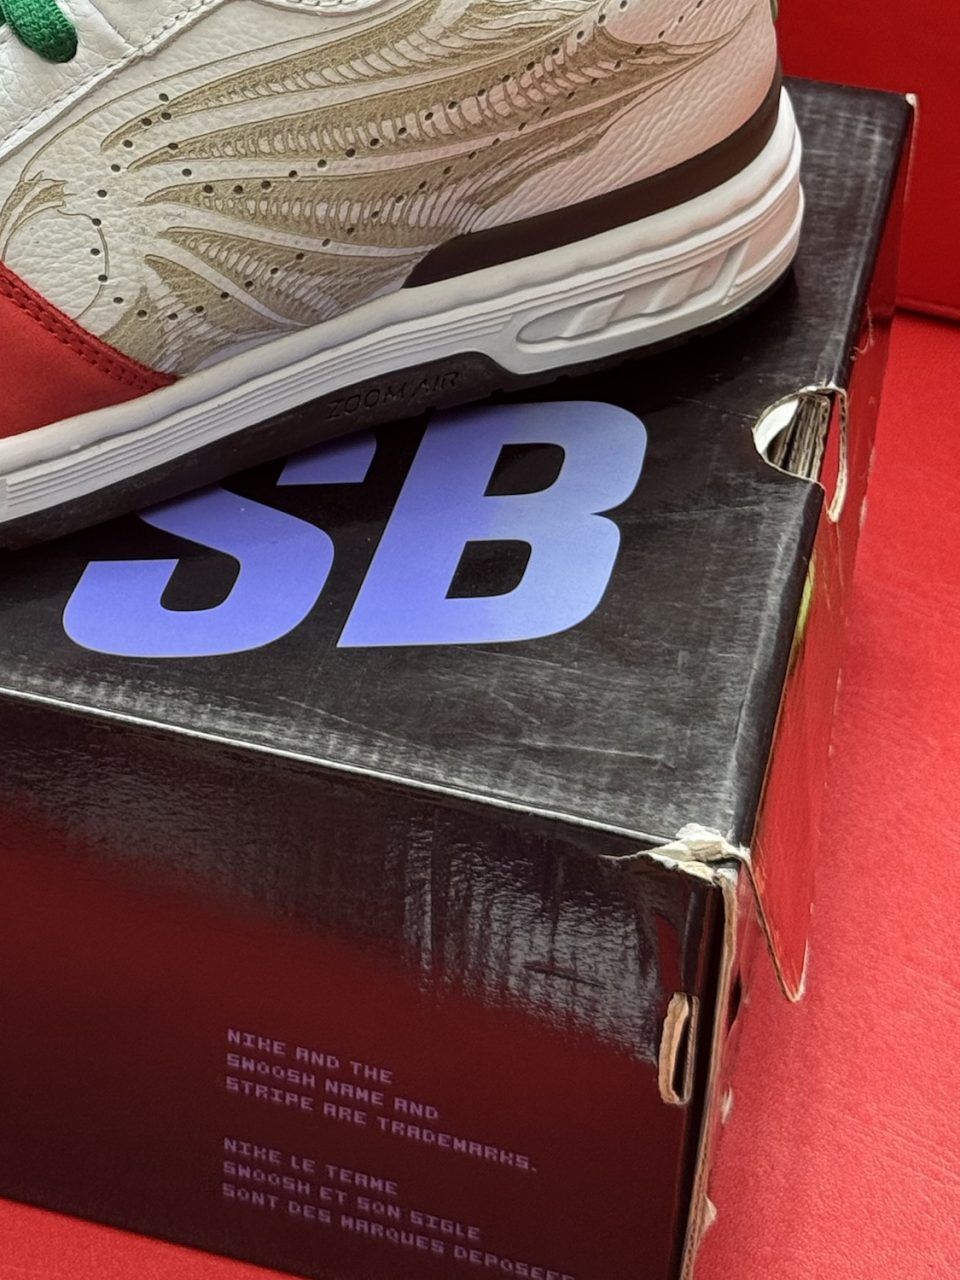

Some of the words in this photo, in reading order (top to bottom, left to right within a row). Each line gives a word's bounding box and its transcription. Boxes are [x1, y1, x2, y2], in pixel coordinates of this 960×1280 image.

[329, 382, 406, 418] ZOOM
[412, 371, 459, 397] AIR
[63, 400, 647, 658] SB
[227, 1028, 286, 1055] NIKE
[296, 1047, 339, 1069] AND
[350, 1061, 392, 1084] THE
[227, 1053, 315, 1088] SWOOSH
[325, 1078, 384, 1106] NAME
[394, 1097, 438, 1119] AND
[226, 1076, 313, 1111] STRIPE
[323, 1102, 367, 1125] ARE
[377, 1116, 537, 1173] TRADEMARKS.
[224, 1137, 281, 1164] NIKE
[291, 1155, 315, 1173] LE
[325, 1164, 398, 1195] TERME
[222, 1183, 279, 1209] SONT
[289, 1200, 331, 1223] DES
[341, 1215, 444, 1254] MARQUES
[223, 1161, 310, 1195] SWOOSH
[319, 1186, 347, 1204] ET
[357, 1196, 400, 1219] SON
[410, 1210, 480, 1240] SIGLE
